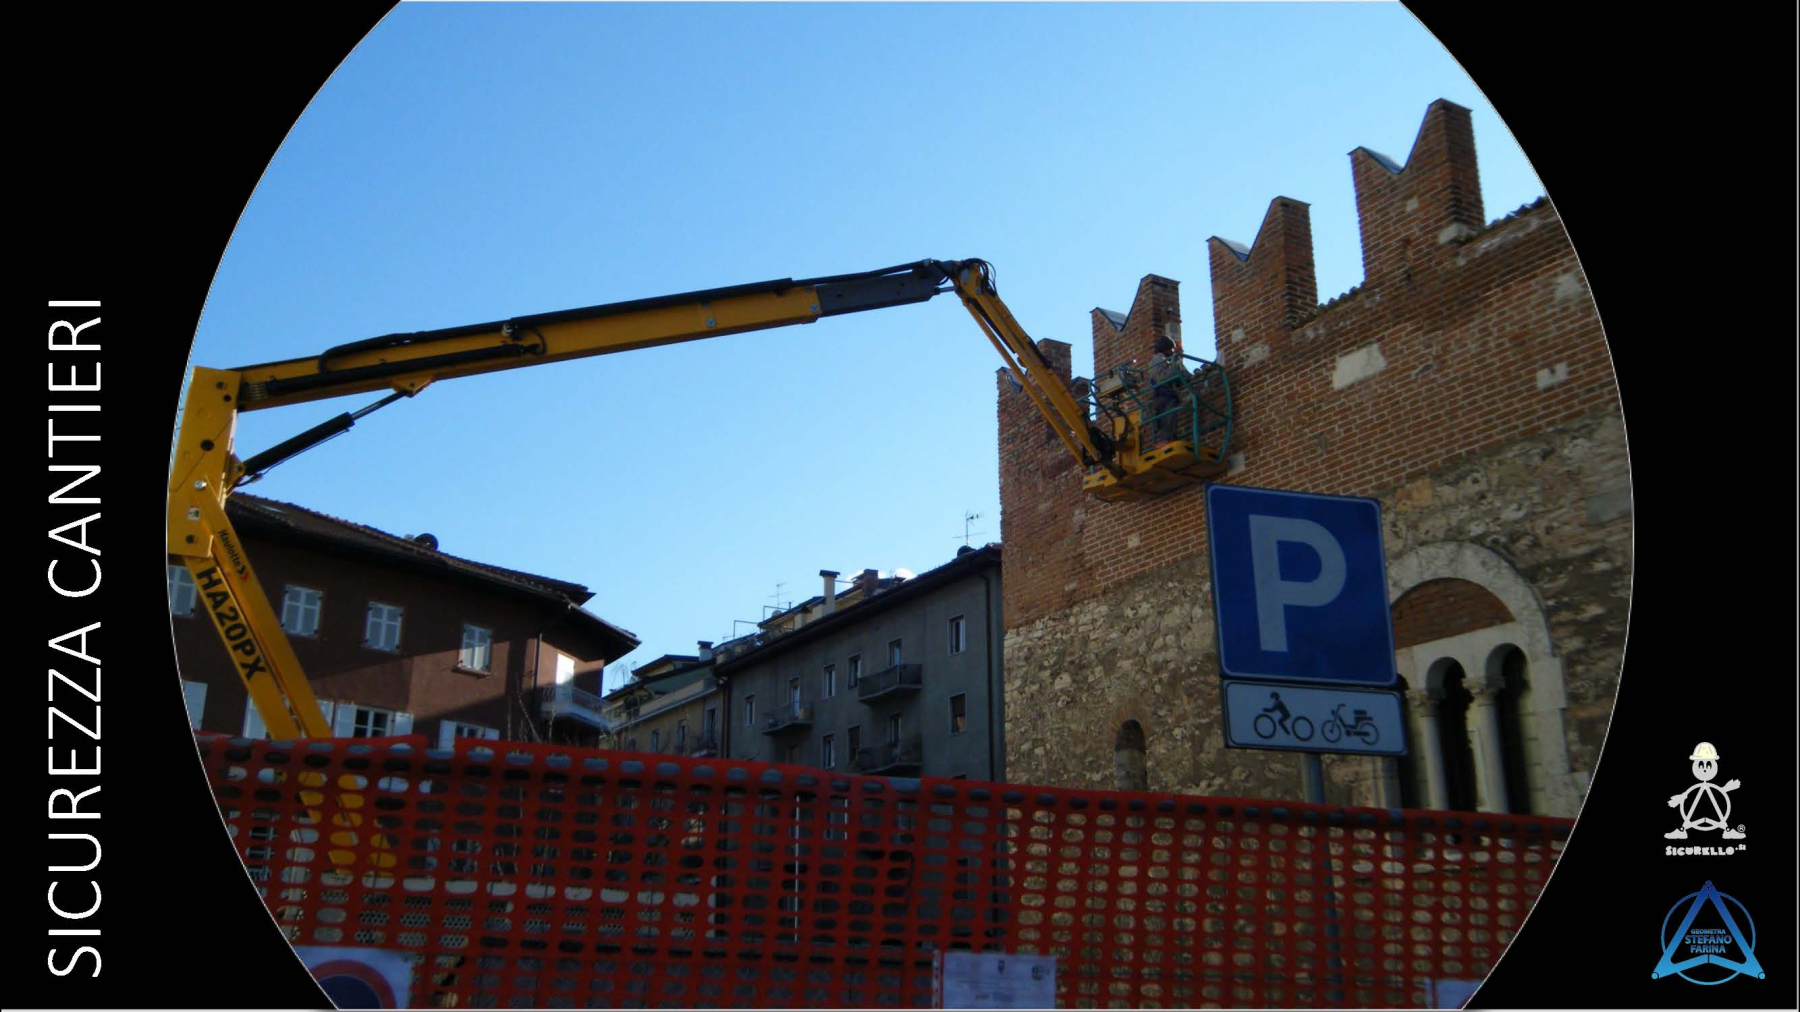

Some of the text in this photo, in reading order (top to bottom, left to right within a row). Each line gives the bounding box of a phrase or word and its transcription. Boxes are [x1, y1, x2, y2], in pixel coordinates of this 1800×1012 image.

[218, 529, 242, 568] Haulotte
[1248, 514, 1348, 652] P
[196, 566, 267, 681] HA20PX
